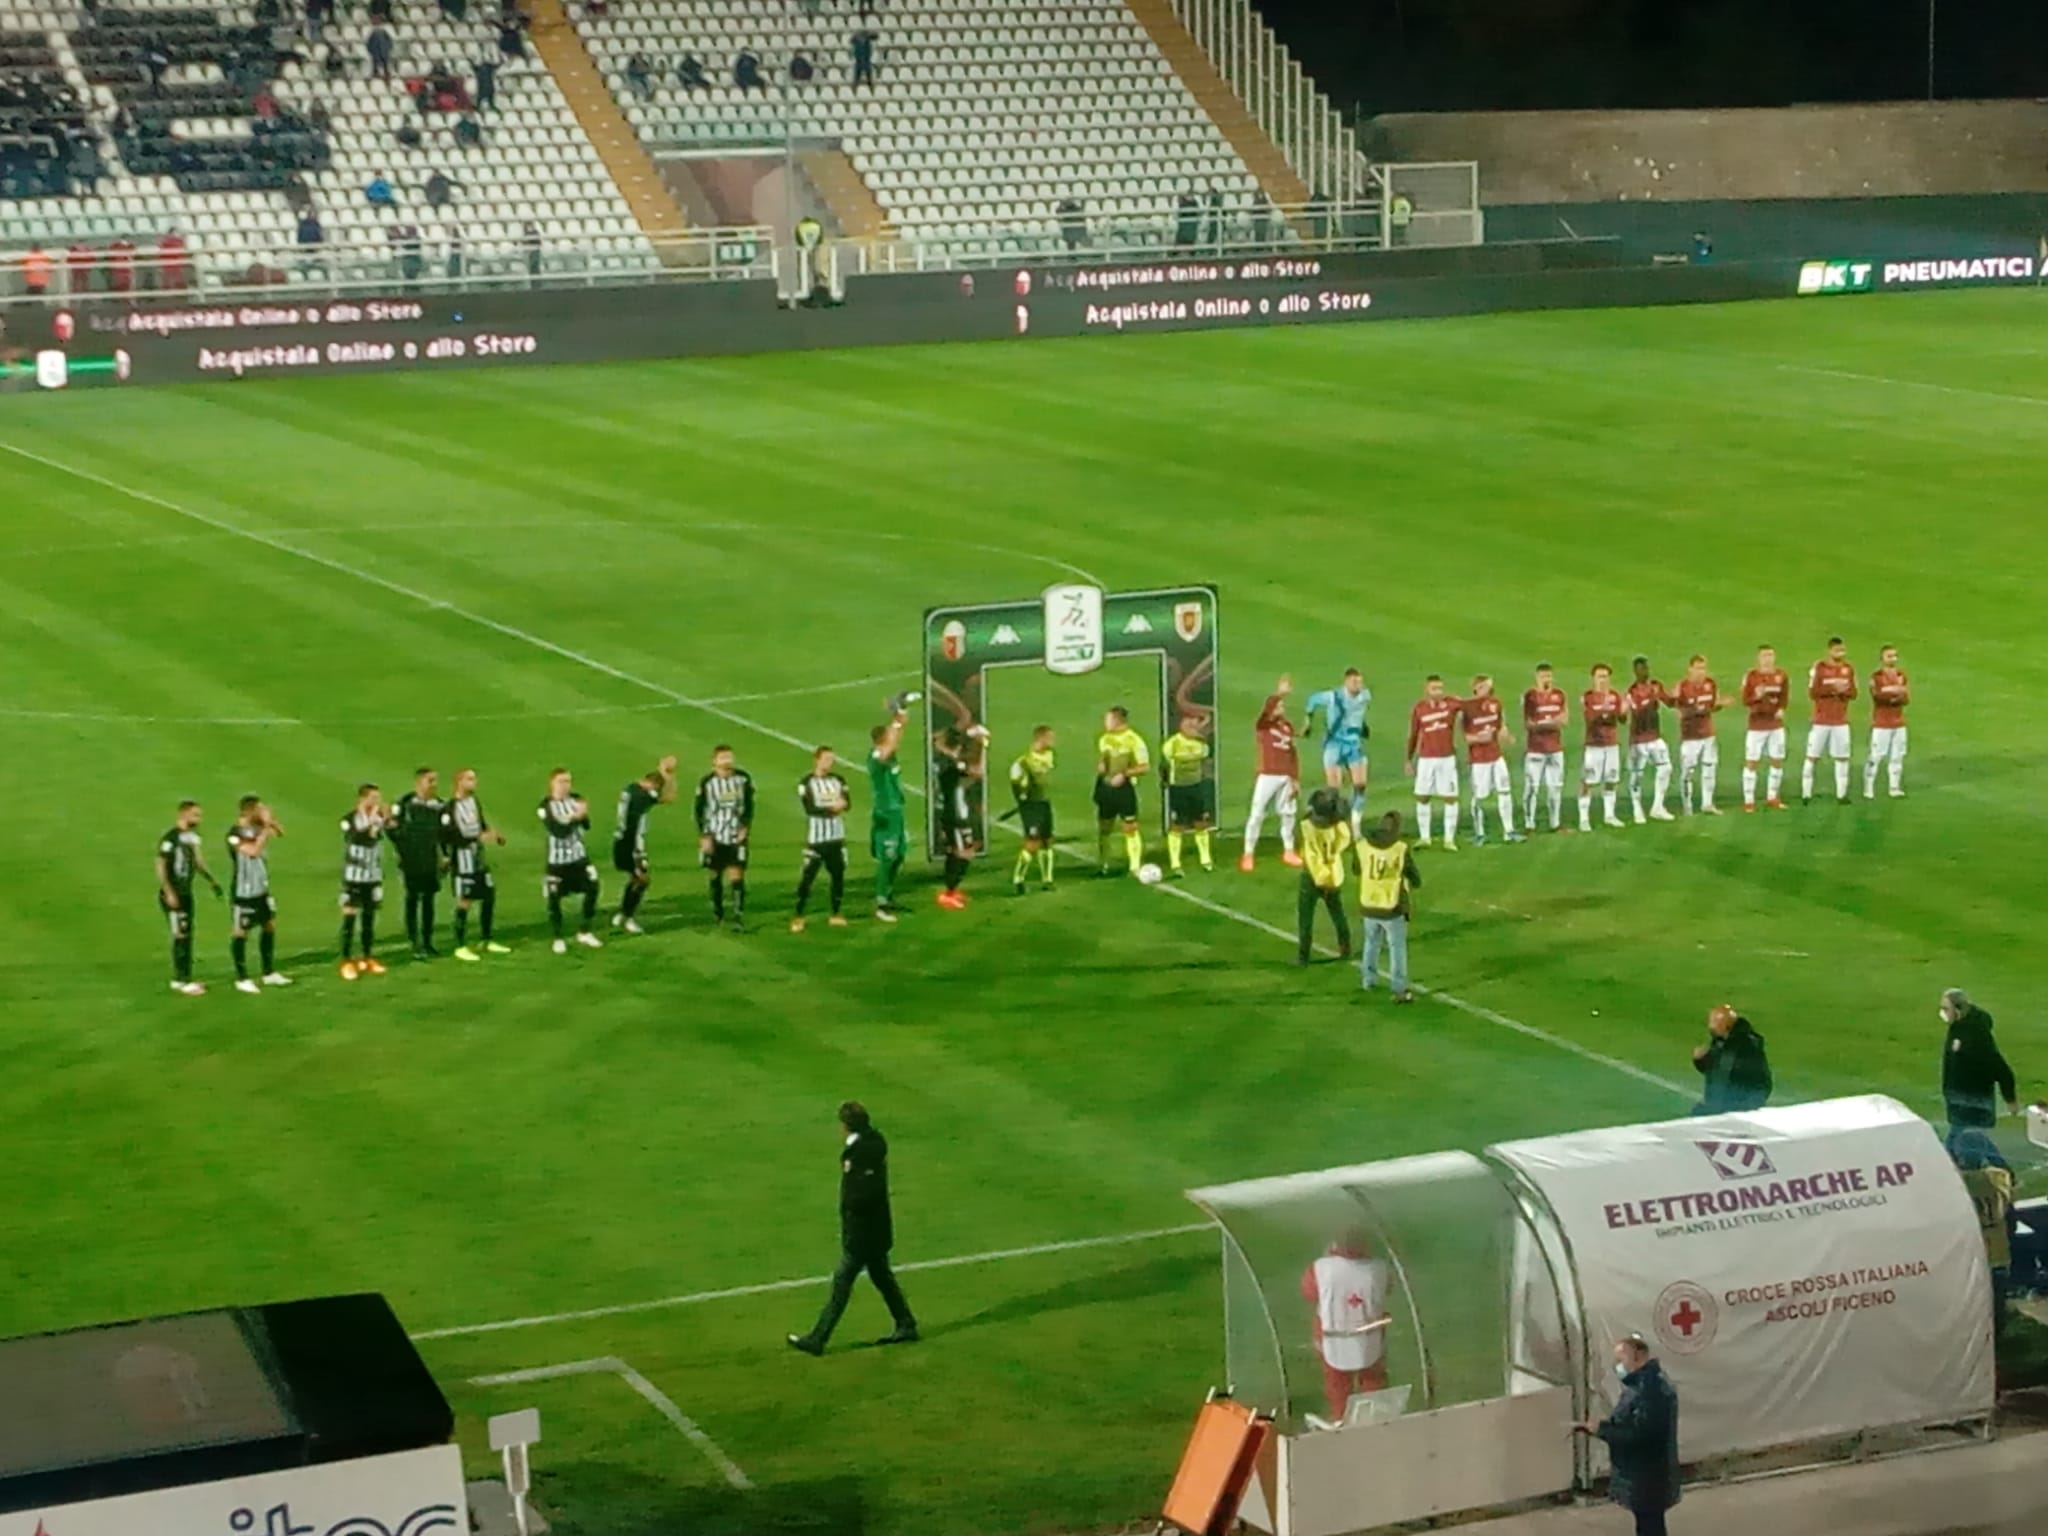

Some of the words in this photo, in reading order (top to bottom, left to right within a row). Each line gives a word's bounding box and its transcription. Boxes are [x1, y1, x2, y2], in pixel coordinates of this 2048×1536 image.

[1077, 268, 1164, 292] Acquistala
[1168, 265, 1218, 282] Online
[1240, 262, 1270, 279] allo
[1274, 260, 1321, 276] Store
[1799, 264, 1871, 289] BKT
[1884, 257, 2033, 283] PNEUMATICI
[1086, 300, 1188, 330] Acquistala
[1194, 298, 1252, 318] Online
[1278, 293, 1311, 314] allo
[1318, 291, 1372, 312] Store
[198, 343, 320, 376] Acquistala
[326, 341, 396, 363] Online
[473, 333, 537, 356] Store
[1603, 1168, 1869, 1229] ELETTROMARCHE
[1876, 1161, 1915, 1188] AP
[1724, 1282, 1785, 1307] CROCE
[1791, 1272, 1849, 1296] ROSSA
[1852, 1260, 1929, 1286] ITALIANA
[1765, 1299, 1828, 1323] ASCOLI
